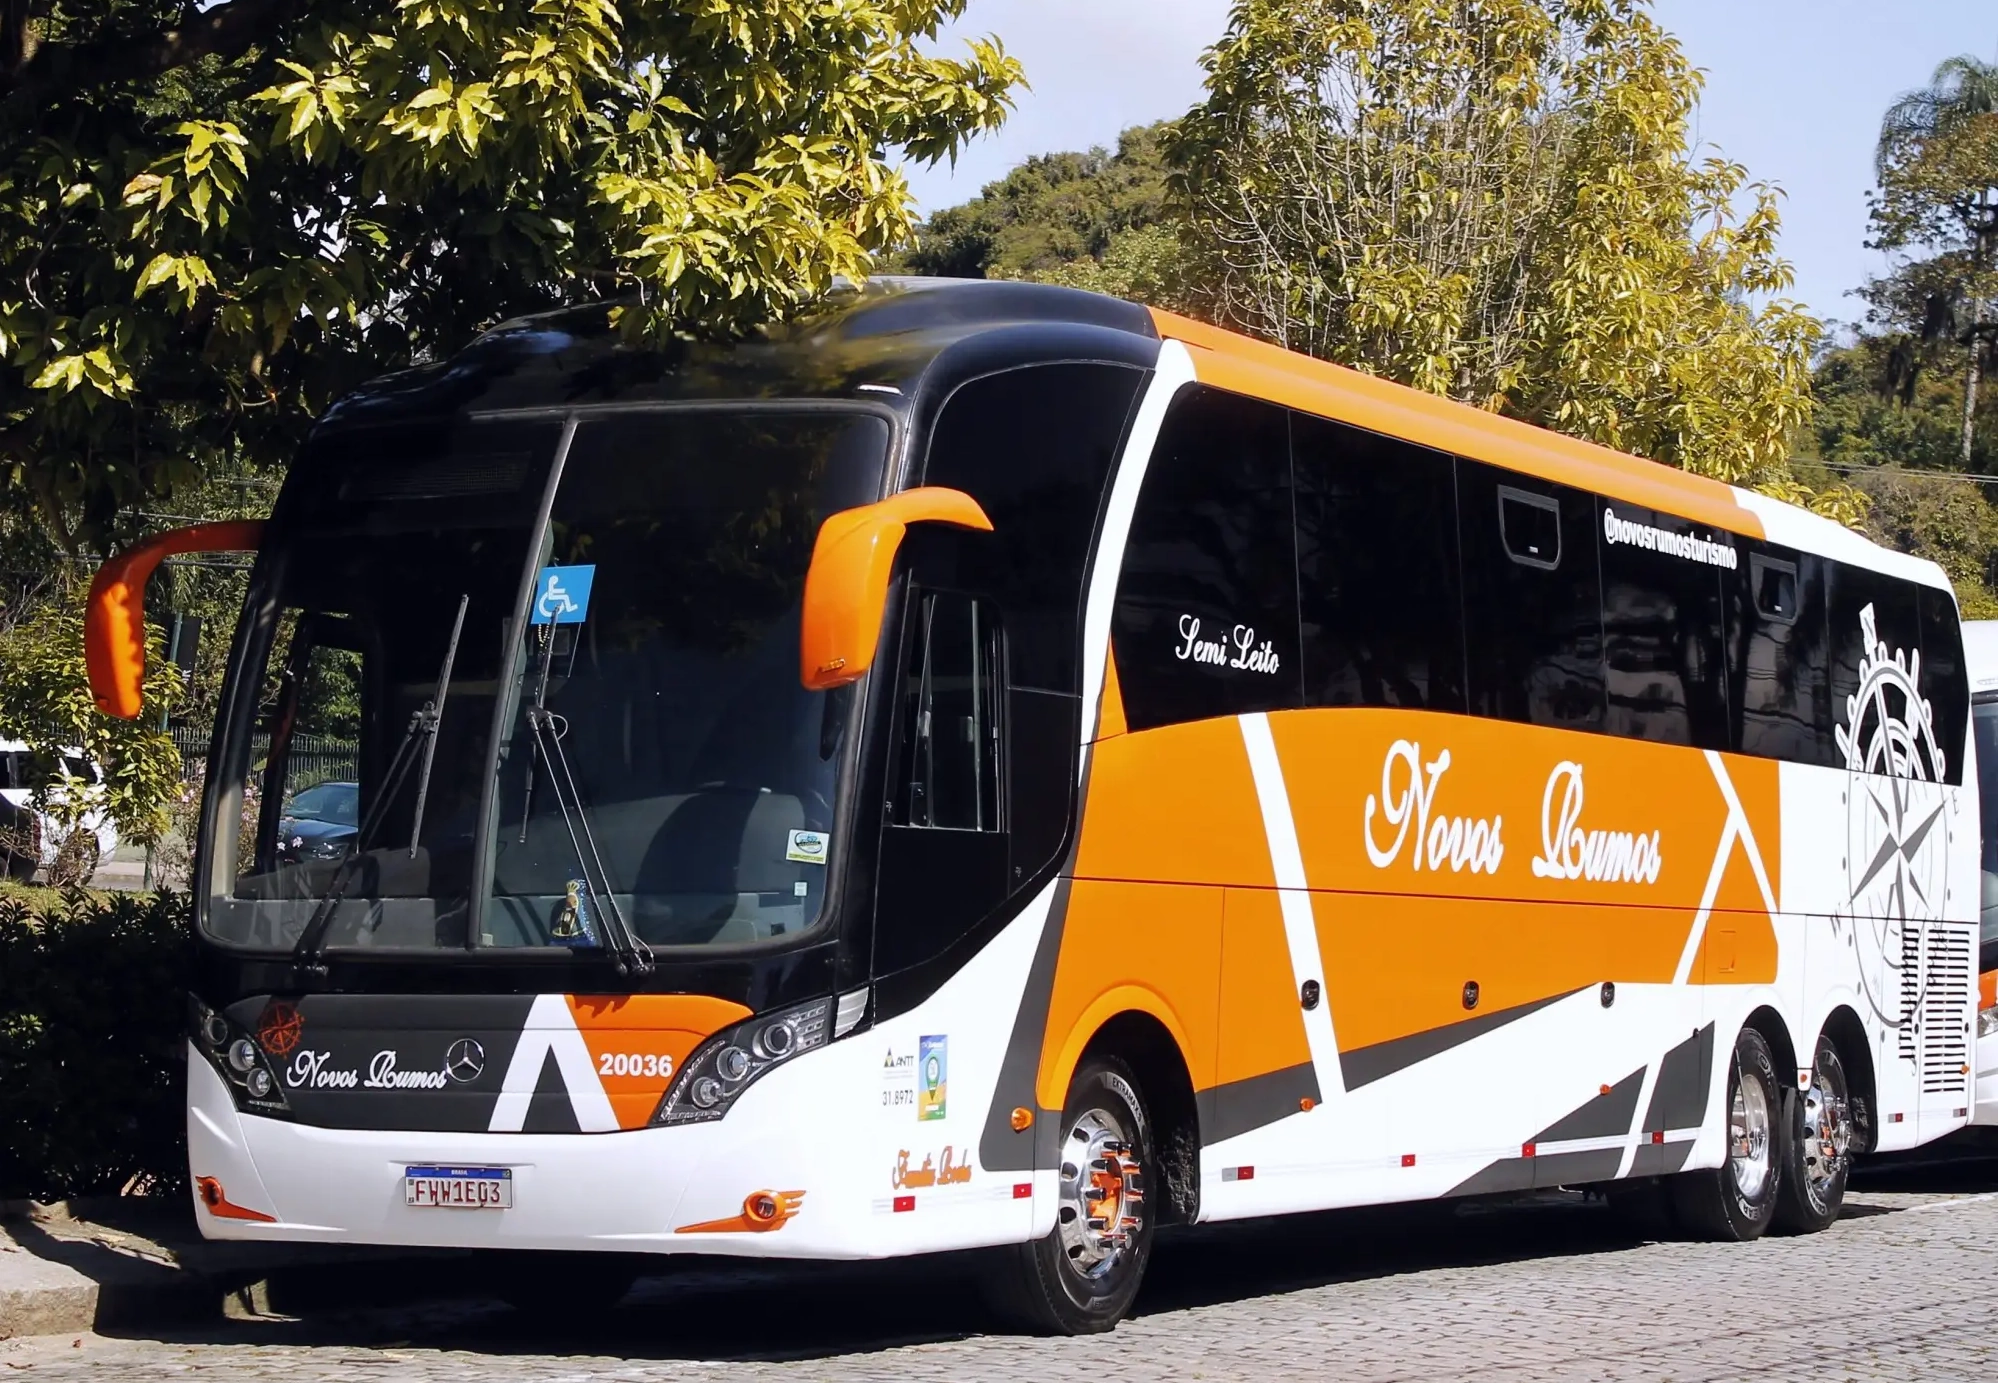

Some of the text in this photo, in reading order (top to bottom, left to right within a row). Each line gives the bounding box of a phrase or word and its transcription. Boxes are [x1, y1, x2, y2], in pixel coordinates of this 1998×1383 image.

[1604, 507, 1738, 571] @novosrumosturismo
[1175, 614, 1280, 675] Semi Leito
[1364, 739, 1662, 885] Novos Rumos
[286, 1050, 447, 1089] Novos Rumos
[598, 1053, 673, 1078] 20036
[895, 1055, 915, 1067] ANTT
[882, 1090, 914, 1107] 31.8972
